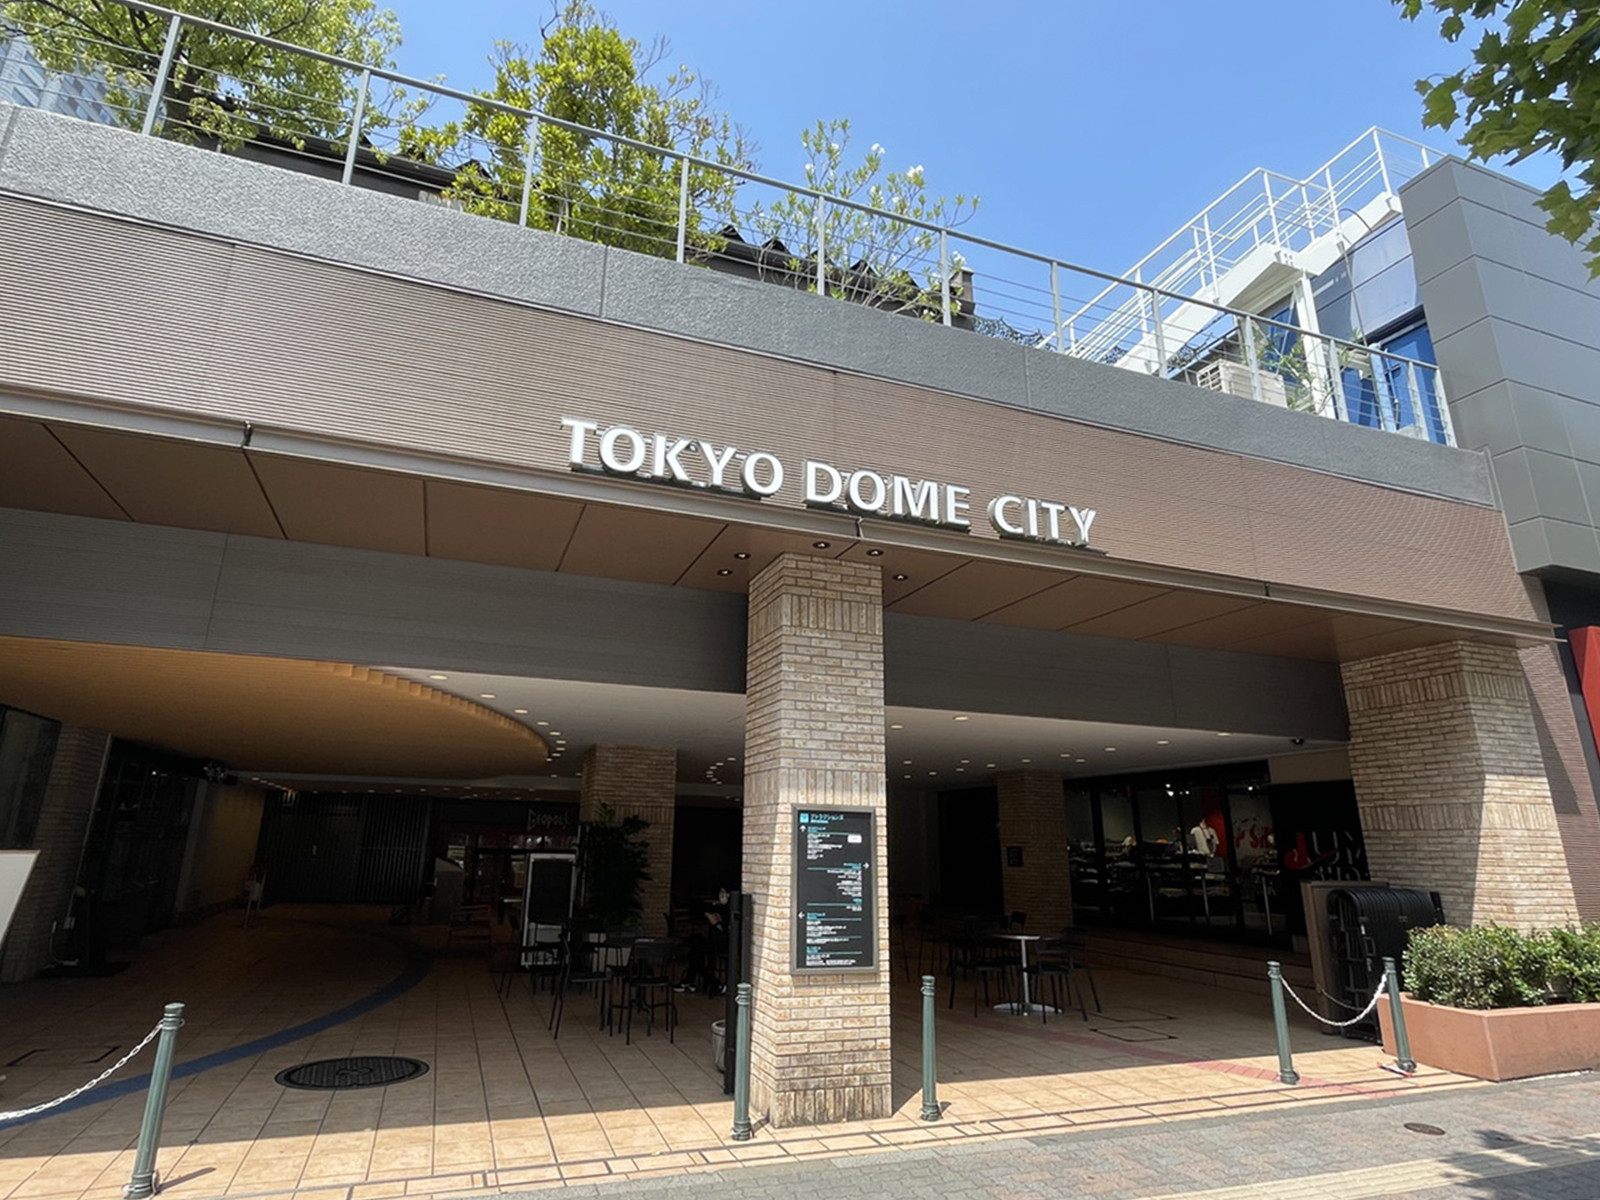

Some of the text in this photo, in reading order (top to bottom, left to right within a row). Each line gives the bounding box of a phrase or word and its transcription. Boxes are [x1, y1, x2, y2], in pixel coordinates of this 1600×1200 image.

[561, 417, 1097, 546] TOKYO DOME CITY
